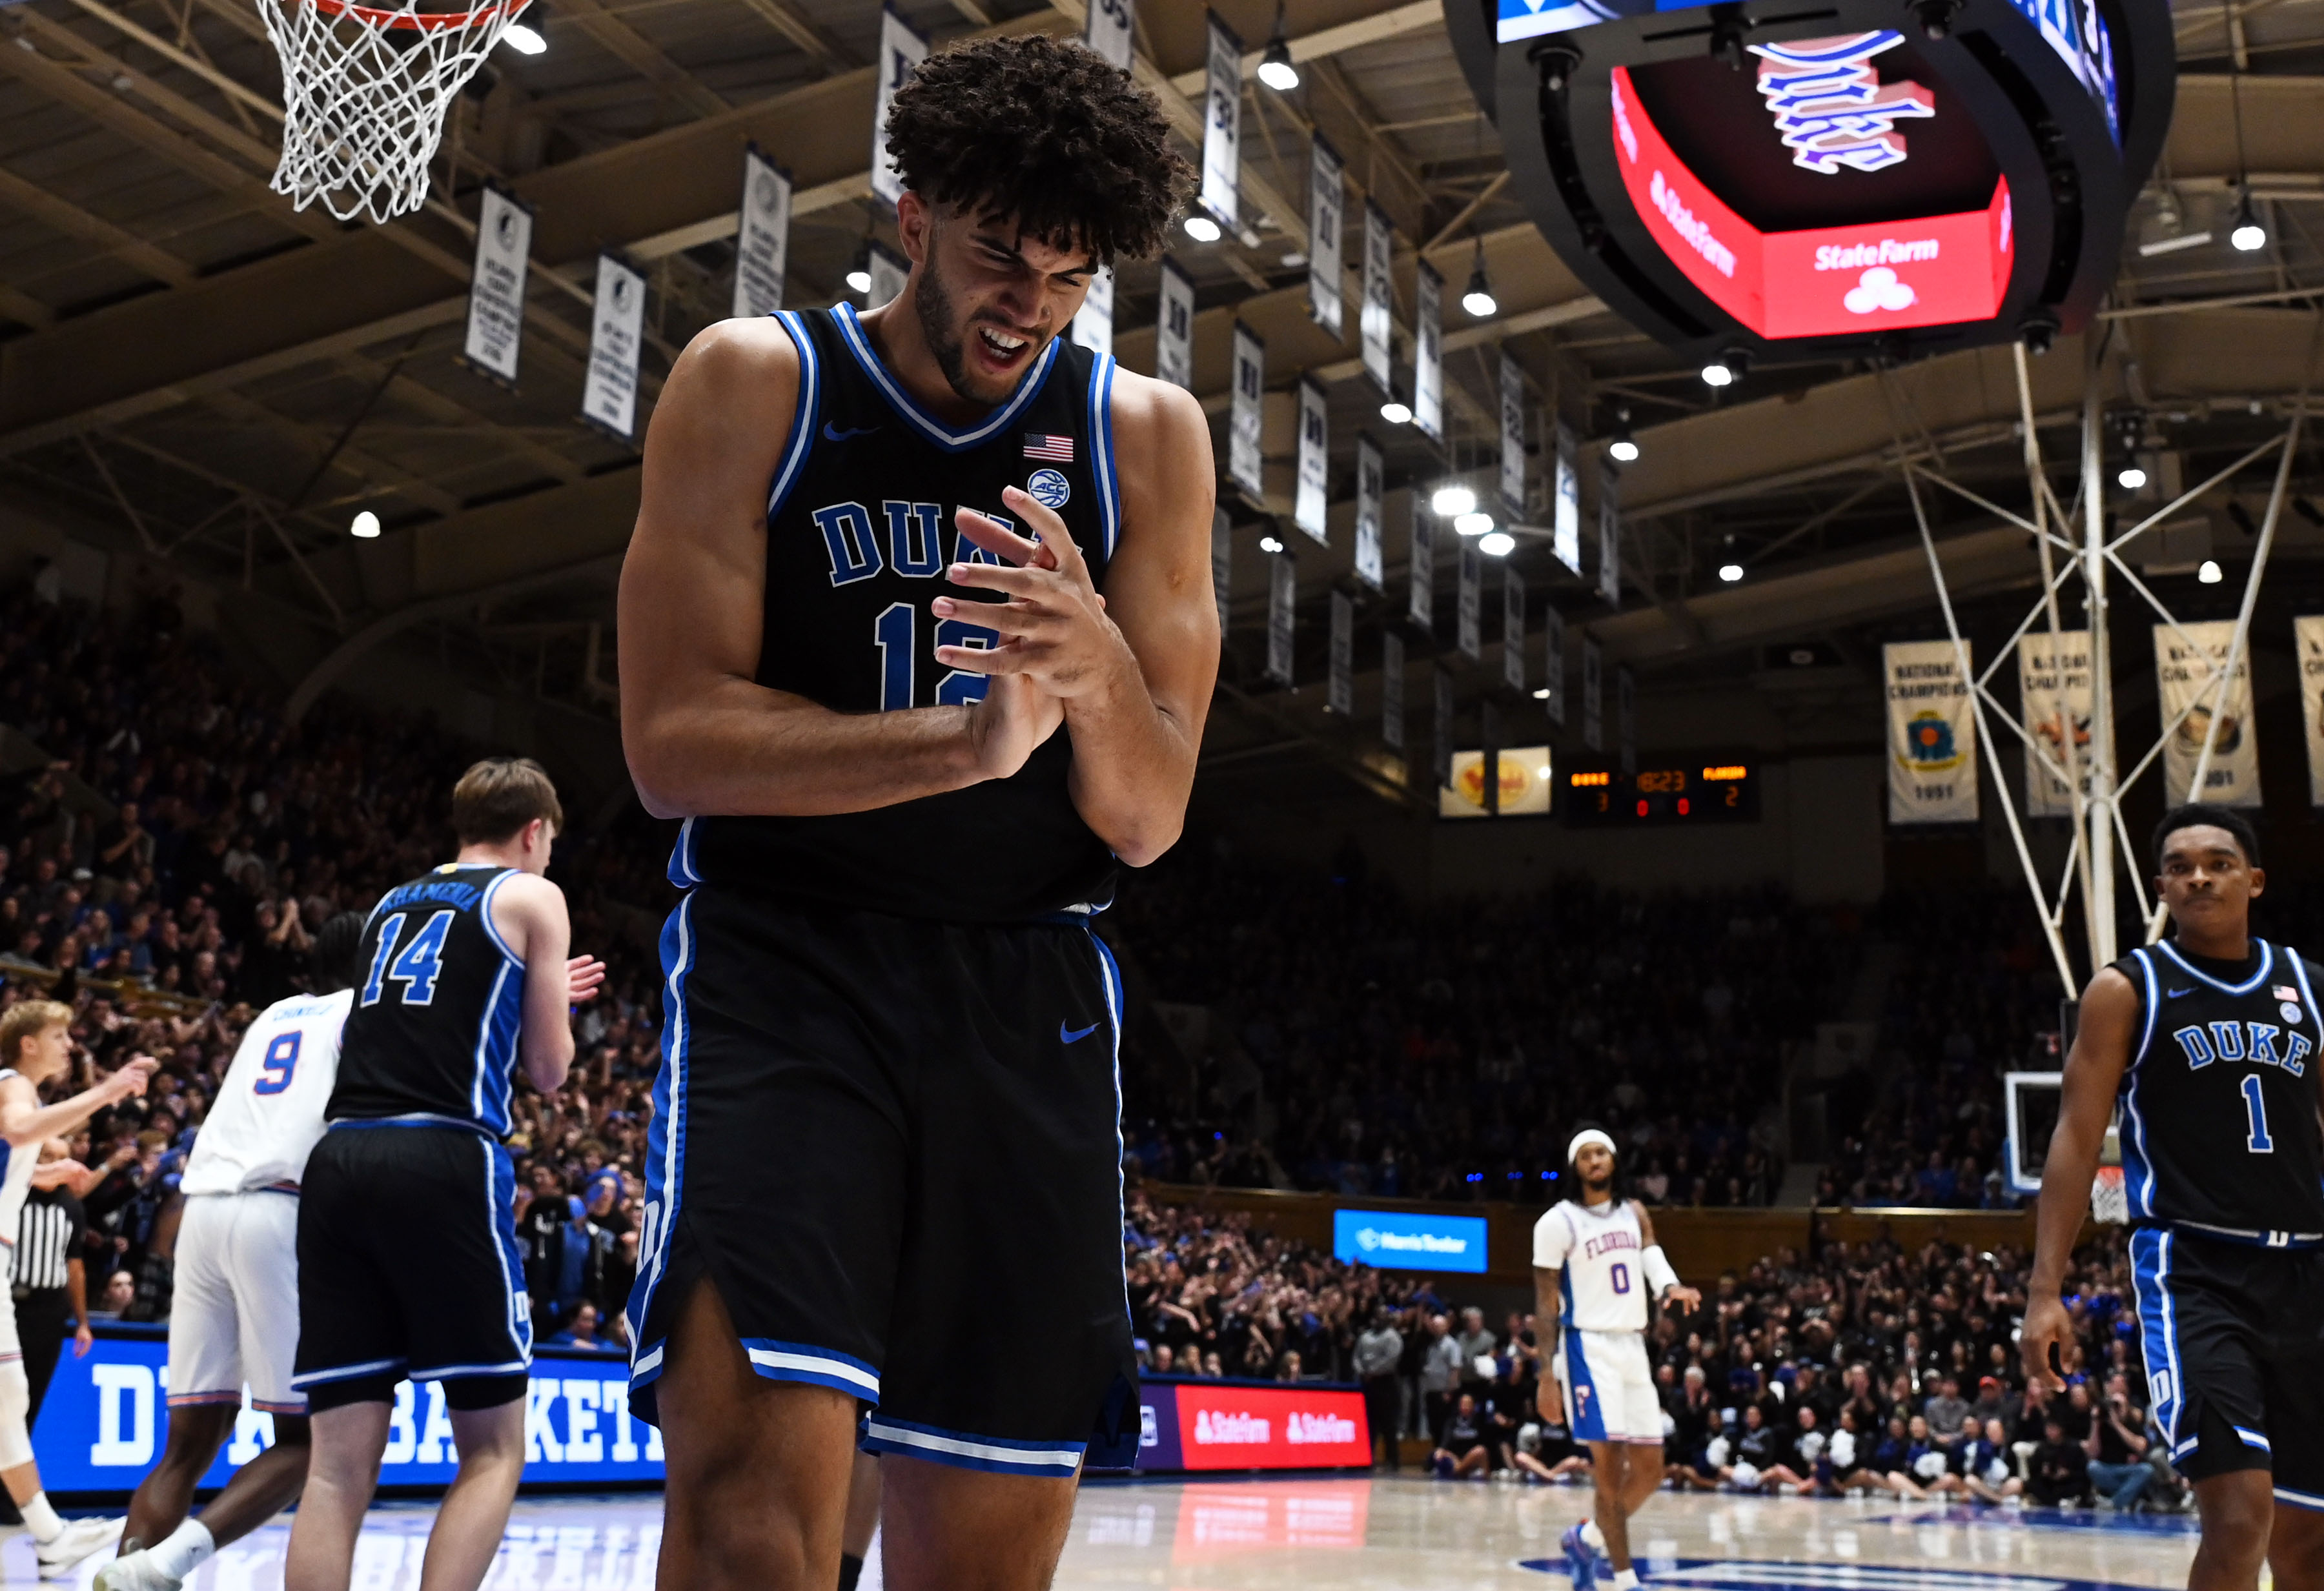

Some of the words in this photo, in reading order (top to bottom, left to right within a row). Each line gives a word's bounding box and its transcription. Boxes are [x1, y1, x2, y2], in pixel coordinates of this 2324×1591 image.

[1034, 482, 1066, 495] ACC
[812, 500, 1083, 593] DUK
[360, 909, 456, 1008] 14
[253, 1031, 302, 1095] 9
[2173, 1020, 2312, 1077] DUKE
[2240, 1073, 2274, 1153] 1
[1611, 1262, 1630, 1294] 0
[382, 1378, 666, 1464] BAKET
